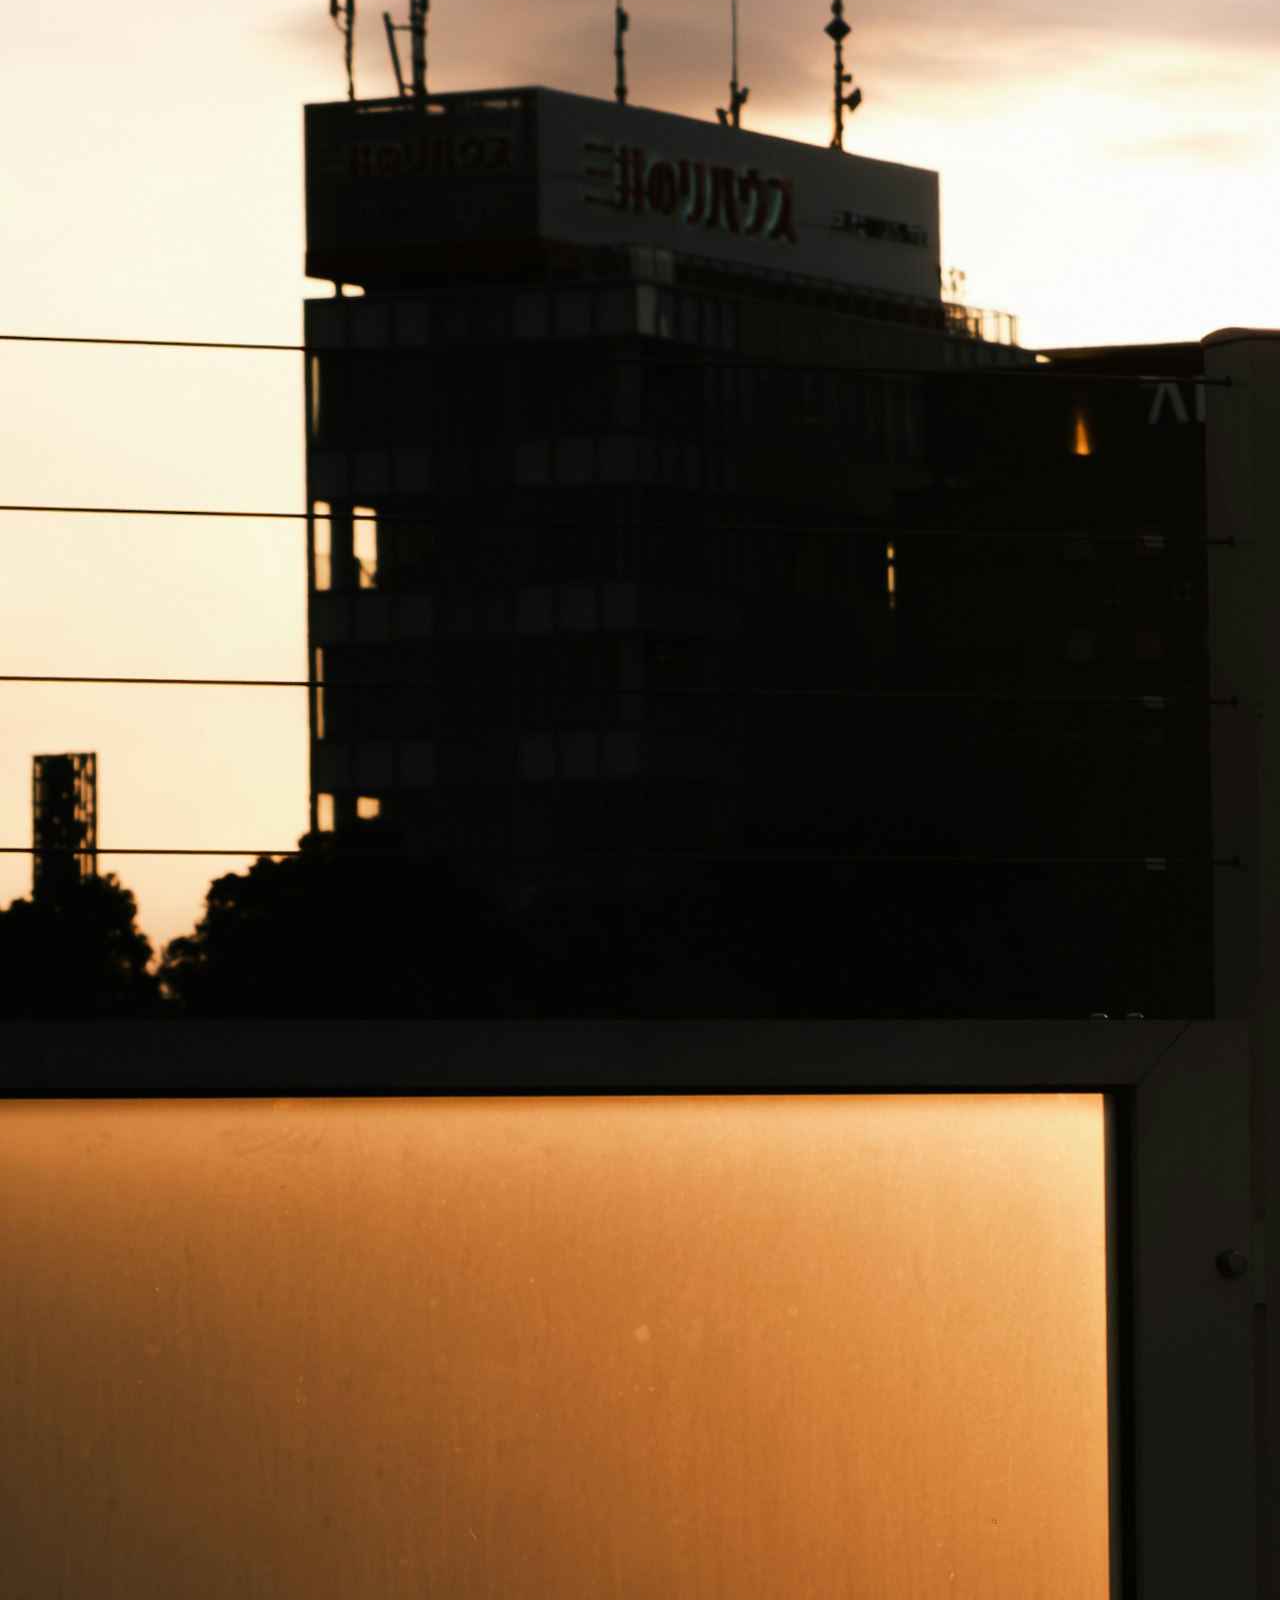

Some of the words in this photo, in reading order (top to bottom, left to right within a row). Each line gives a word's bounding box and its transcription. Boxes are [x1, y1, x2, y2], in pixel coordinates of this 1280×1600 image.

[320, 136, 513, 177] 三井のリハウス
[583, 143, 799, 245] 三井のリハウス
